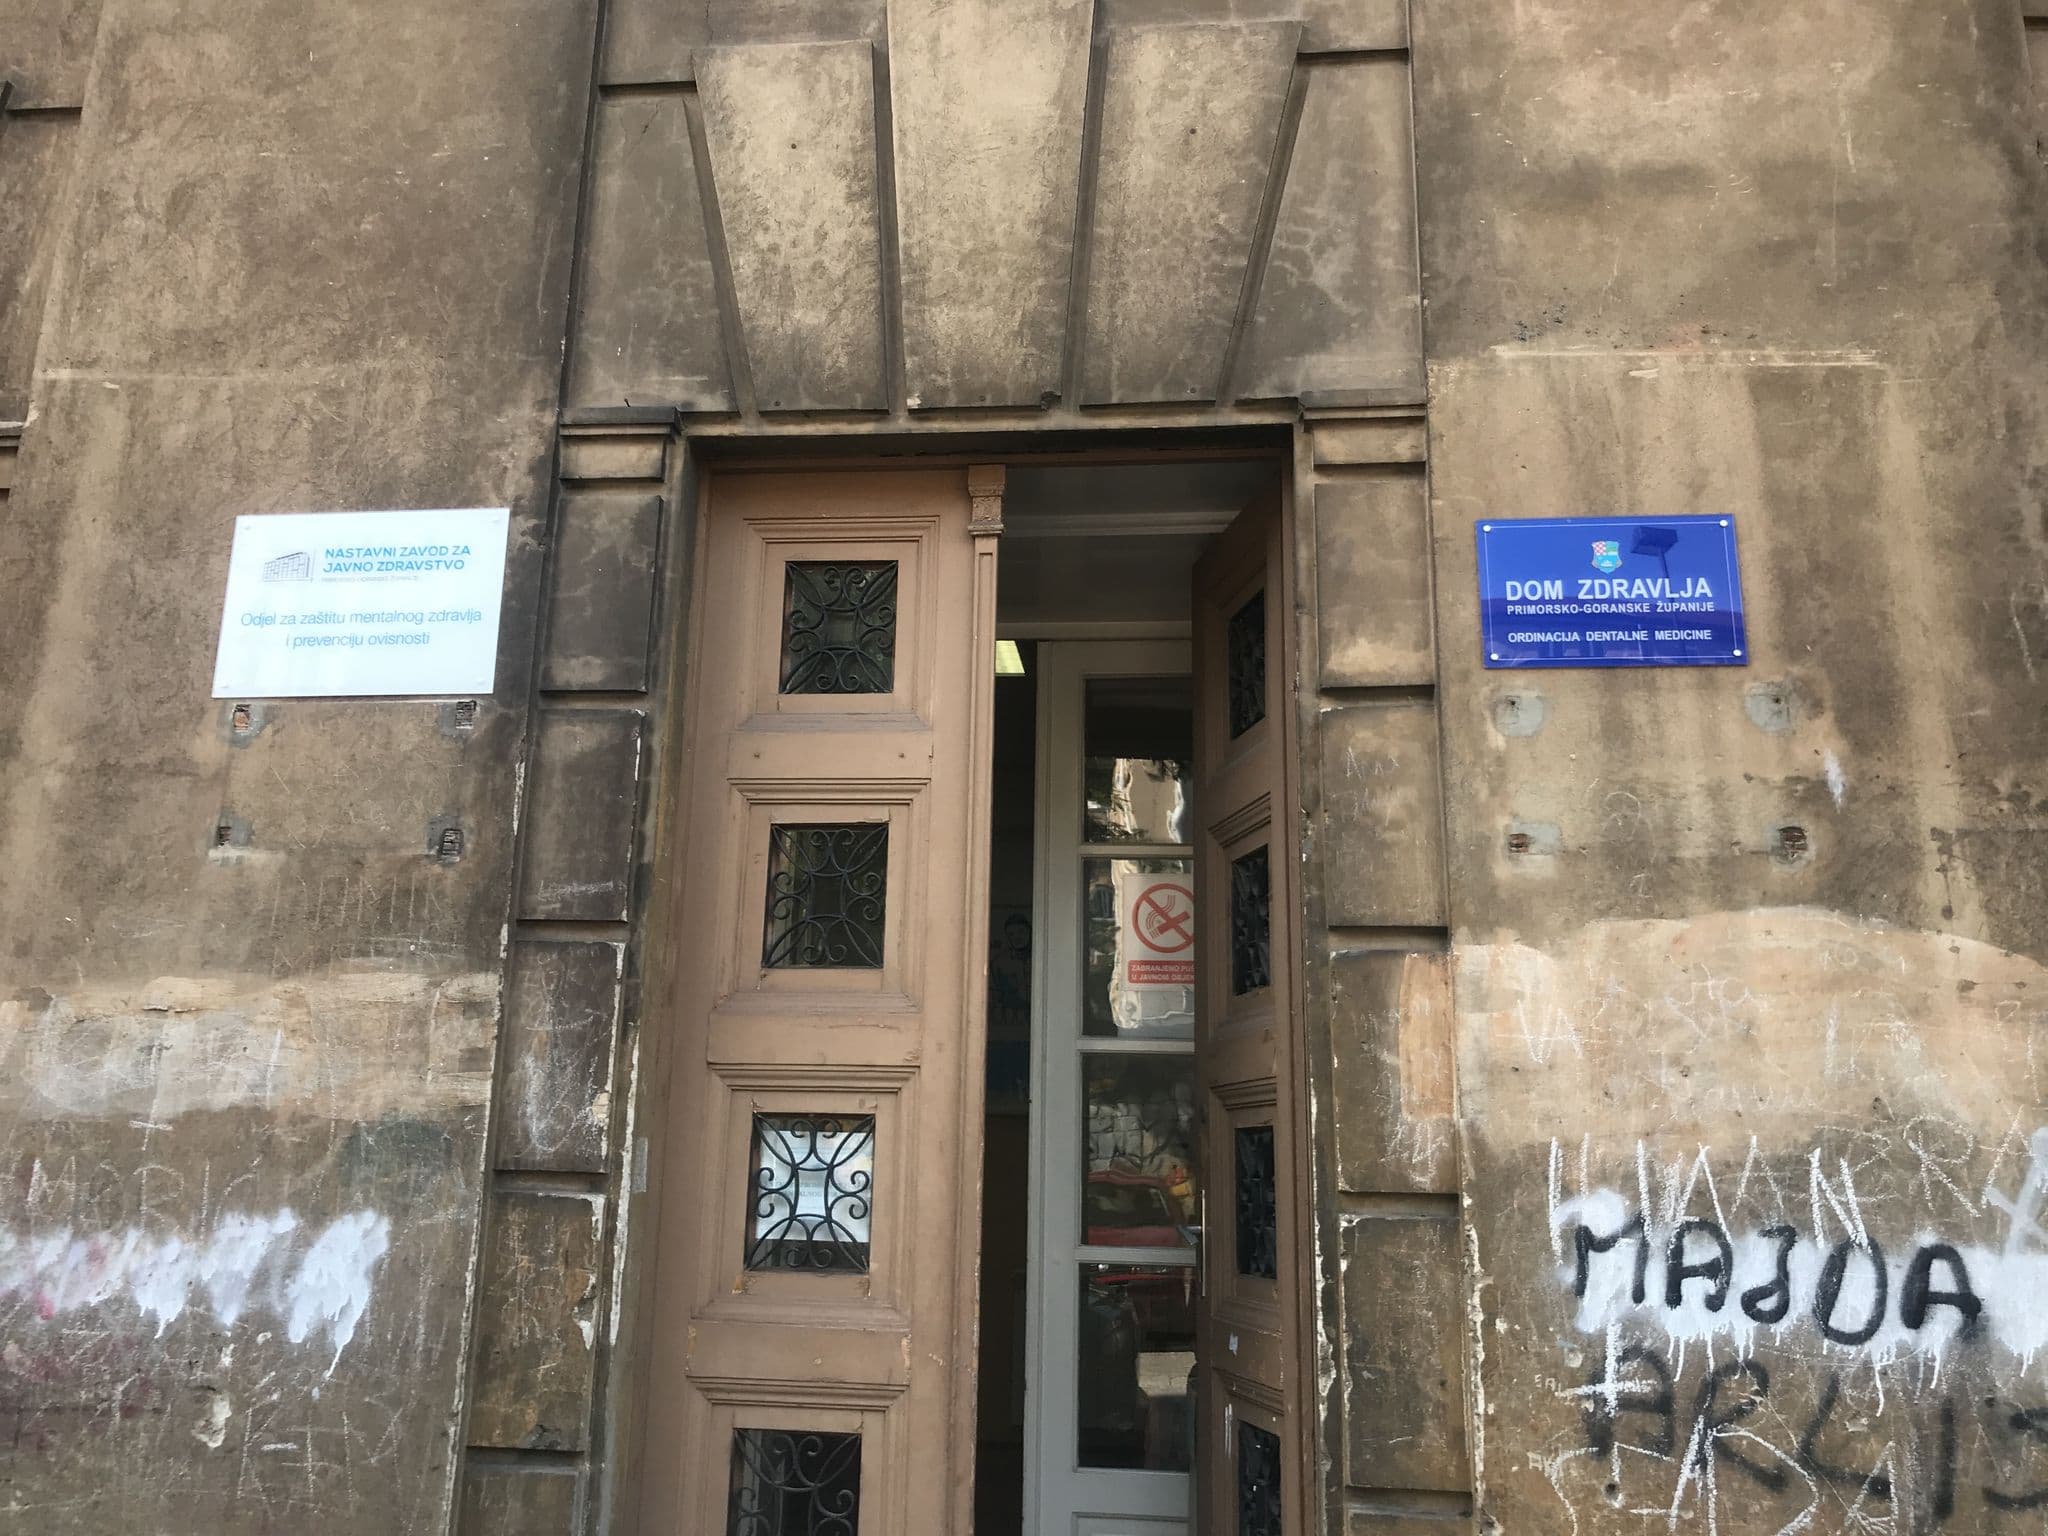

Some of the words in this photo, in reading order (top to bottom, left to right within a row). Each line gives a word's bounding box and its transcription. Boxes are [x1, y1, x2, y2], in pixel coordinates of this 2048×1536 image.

[324, 547, 396, 559] NASTAVNI
[399, 545, 449, 557] ZAVOD
[451, 545, 471, 556] ZA
[323, 561, 373, 573] JAVNO
[376, 559, 465, 572] ZDRAVSTVO
[1505, 580, 1563, 601] DOM
[1577, 577, 1713, 600] ZDRAVLJA
[1506, 602, 1651, 615] PRIMORSKO-GORANSKE
[1656, 600, 1715, 613] ŽUPANIJE
[240, 611, 276, 628] Odjel
[279, 616, 296, 625] za
[300, 610, 346, 626] zaštitu
[350, 609, 423, 625] mentalnog
[427, 607, 482, 625] zdravlja
[292, 632, 364, 649] prevenciju
[367, 631, 431, 646] ovisnosti
[1508, 631, 1581, 643] ORDINACIJA
[1586, 630, 1649, 642] DENTALNE
[1655, 629, 1713, 641] MEDICINE
